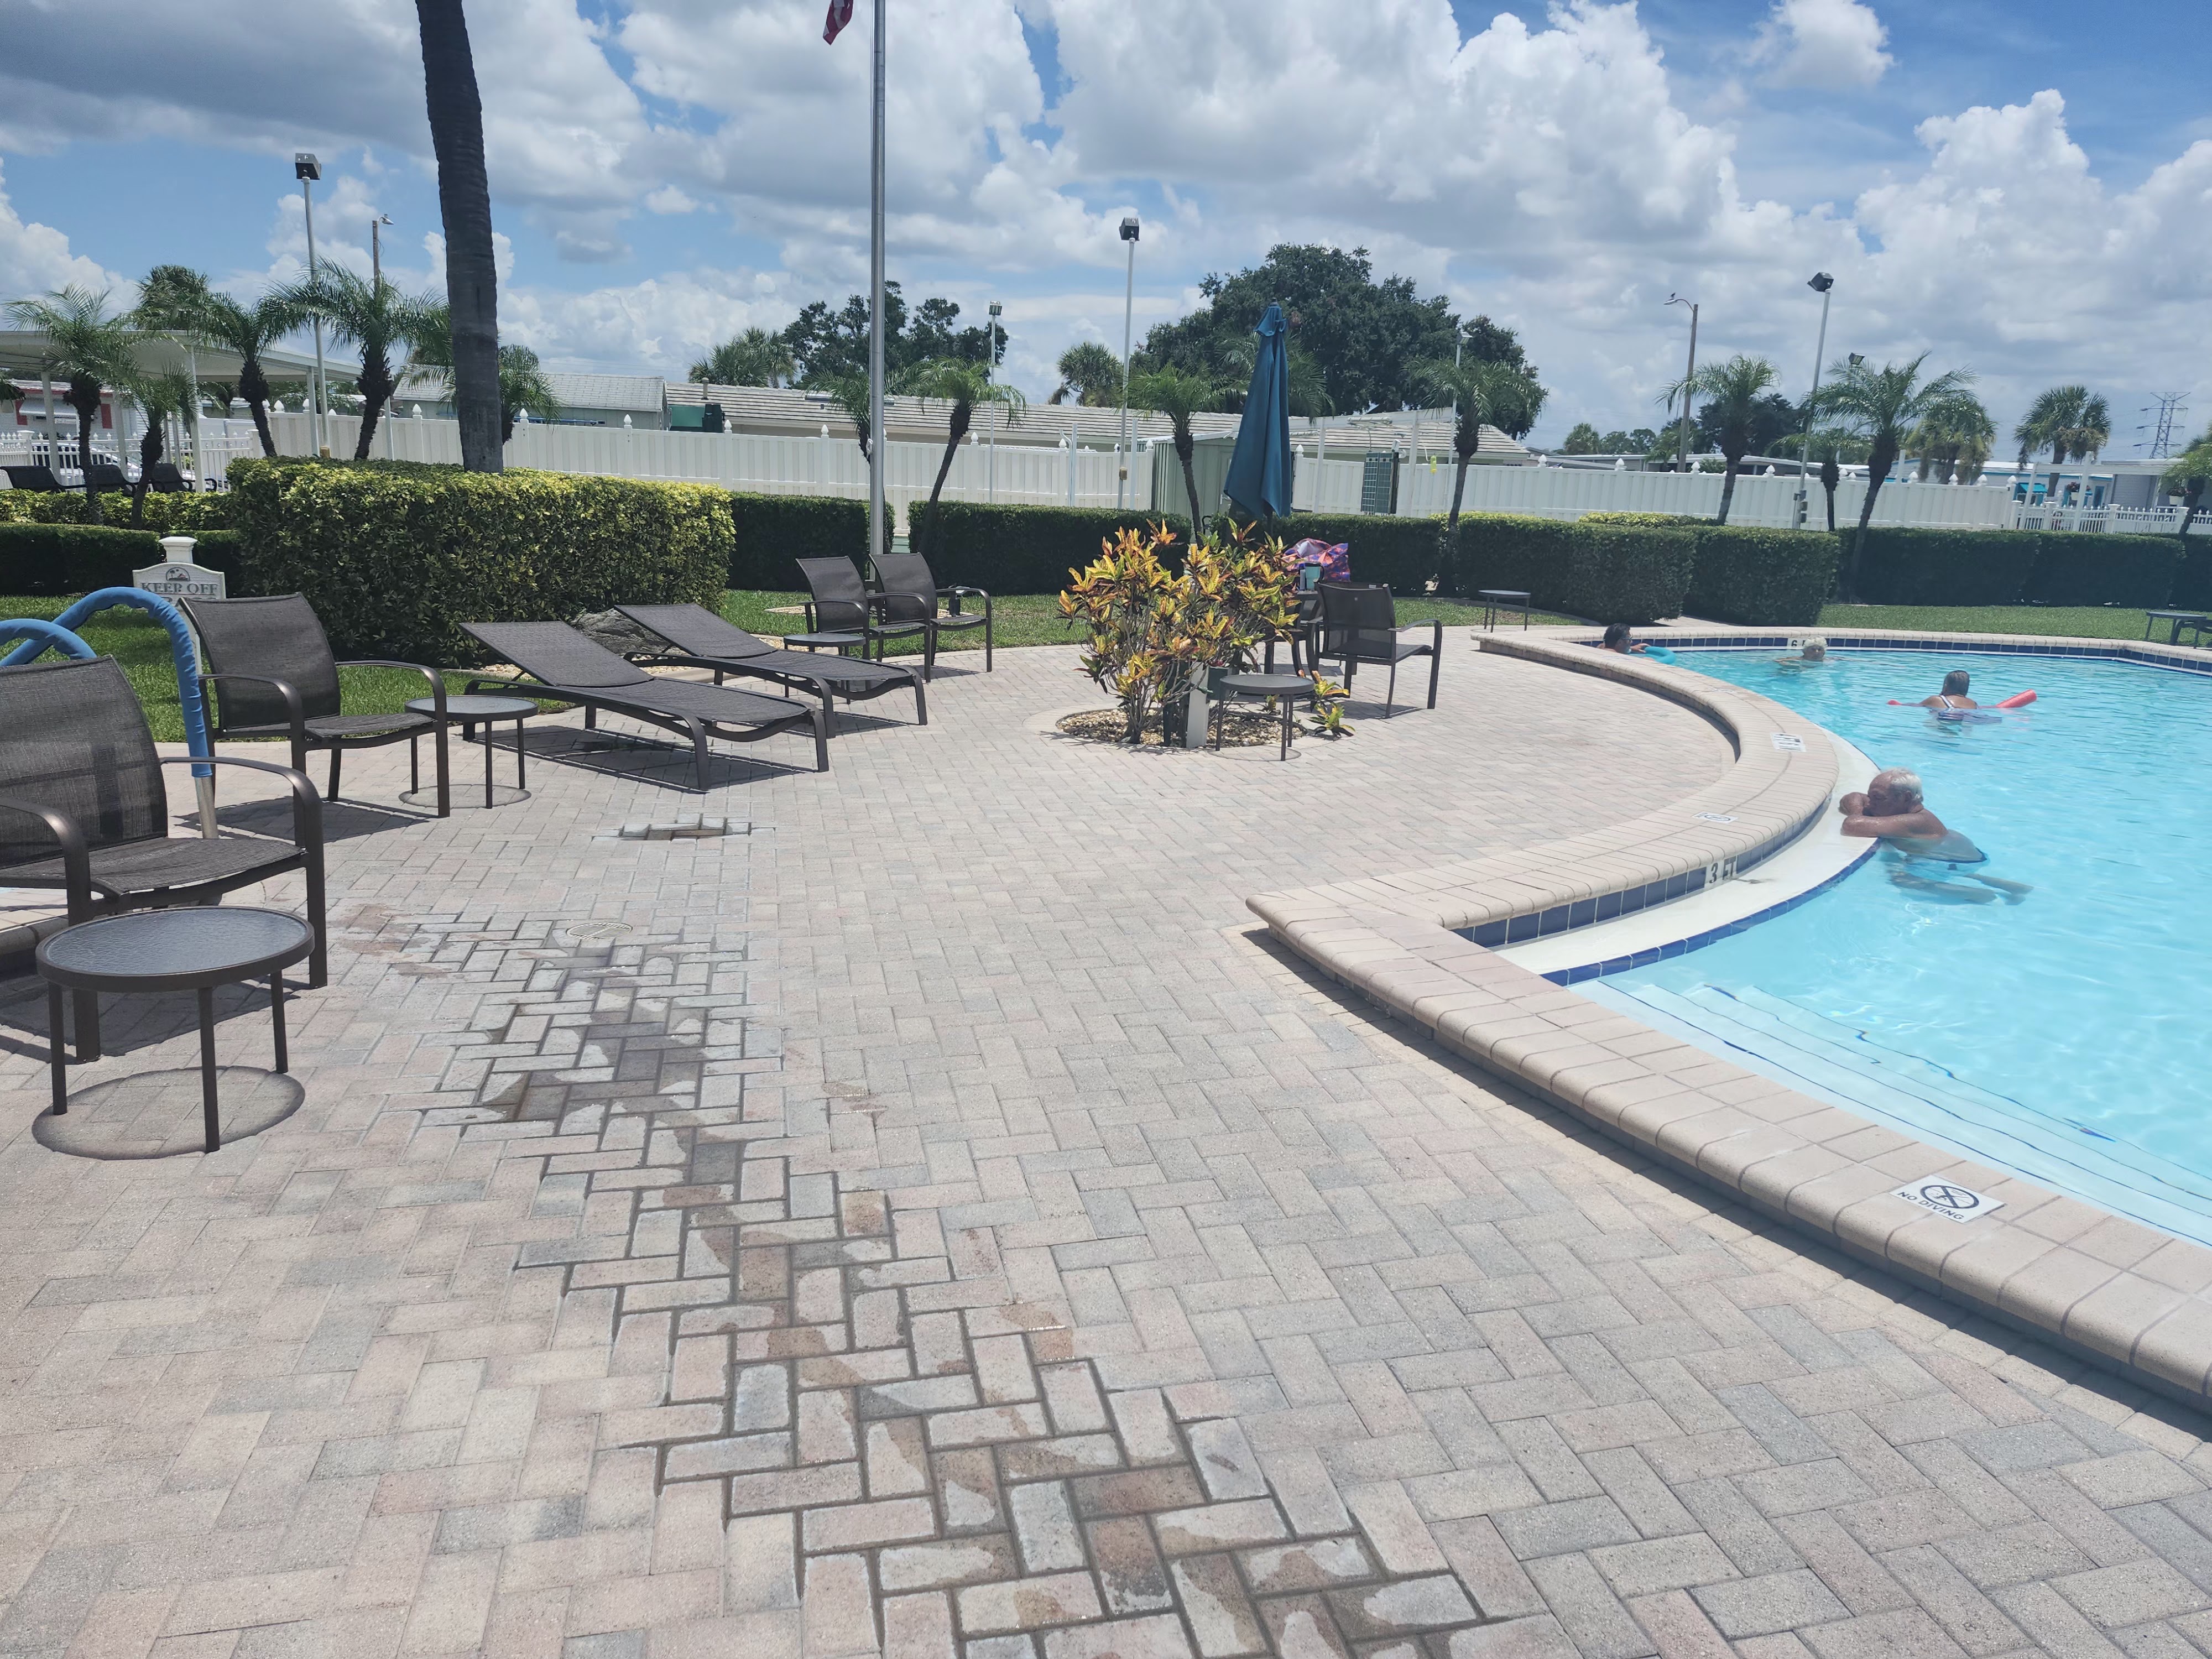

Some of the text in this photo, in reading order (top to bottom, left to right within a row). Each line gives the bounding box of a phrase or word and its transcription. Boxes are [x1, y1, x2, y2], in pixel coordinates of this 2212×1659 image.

[187, 583, 218, 594] OFF
[1709, 856, 1736, 884] 3 FT
[1897, 1191, 1965, 1220] NO DIVING
